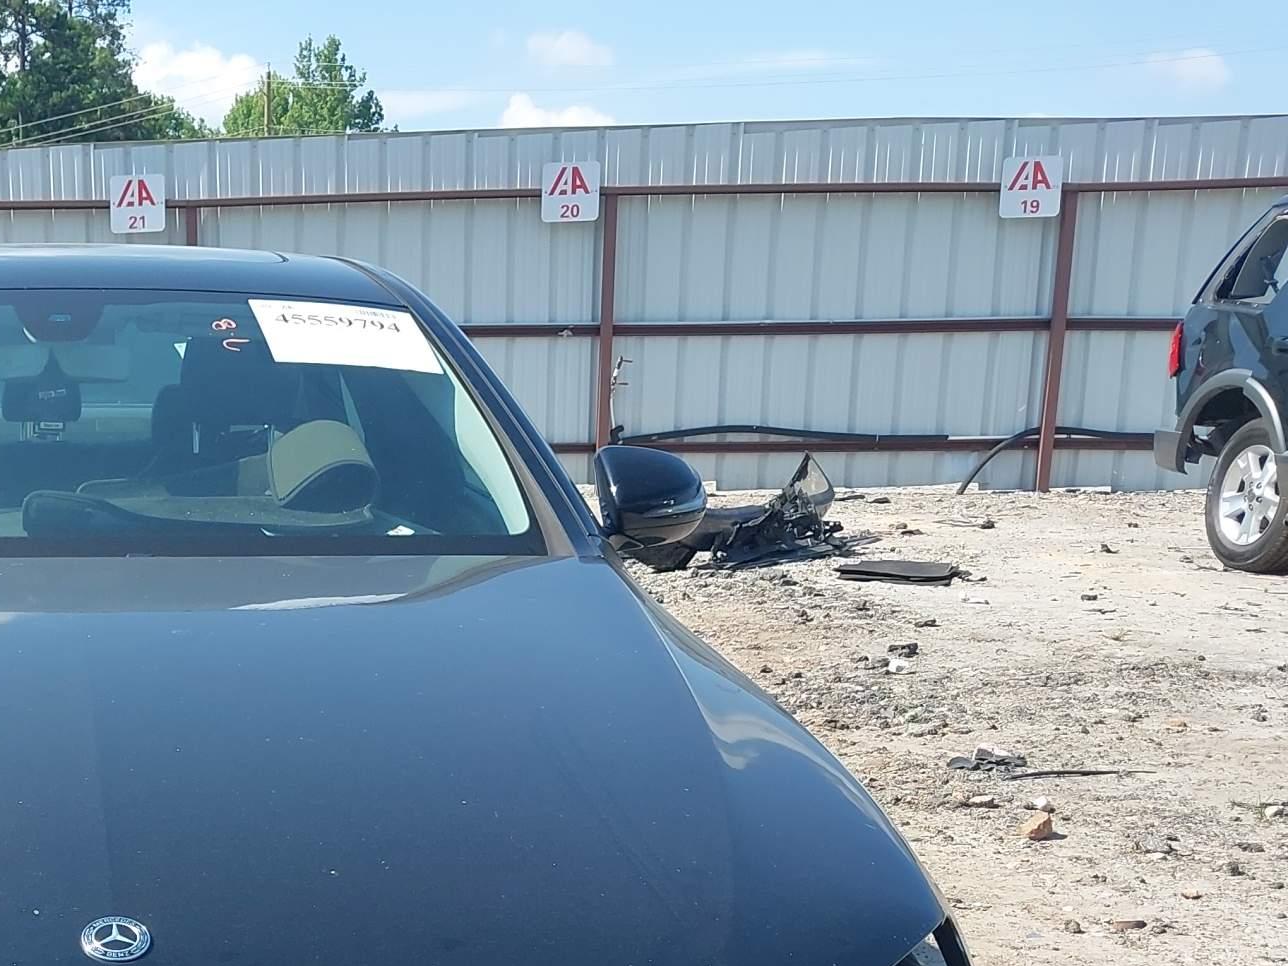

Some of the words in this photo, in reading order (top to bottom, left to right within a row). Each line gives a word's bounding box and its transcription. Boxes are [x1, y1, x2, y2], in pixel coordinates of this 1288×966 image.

[560, 204, 580, 219] 20
[1020, 199, 1040, 214] 19
[128, 215, 145, 229] 21
[274, 312, 401, 333] 45559794
